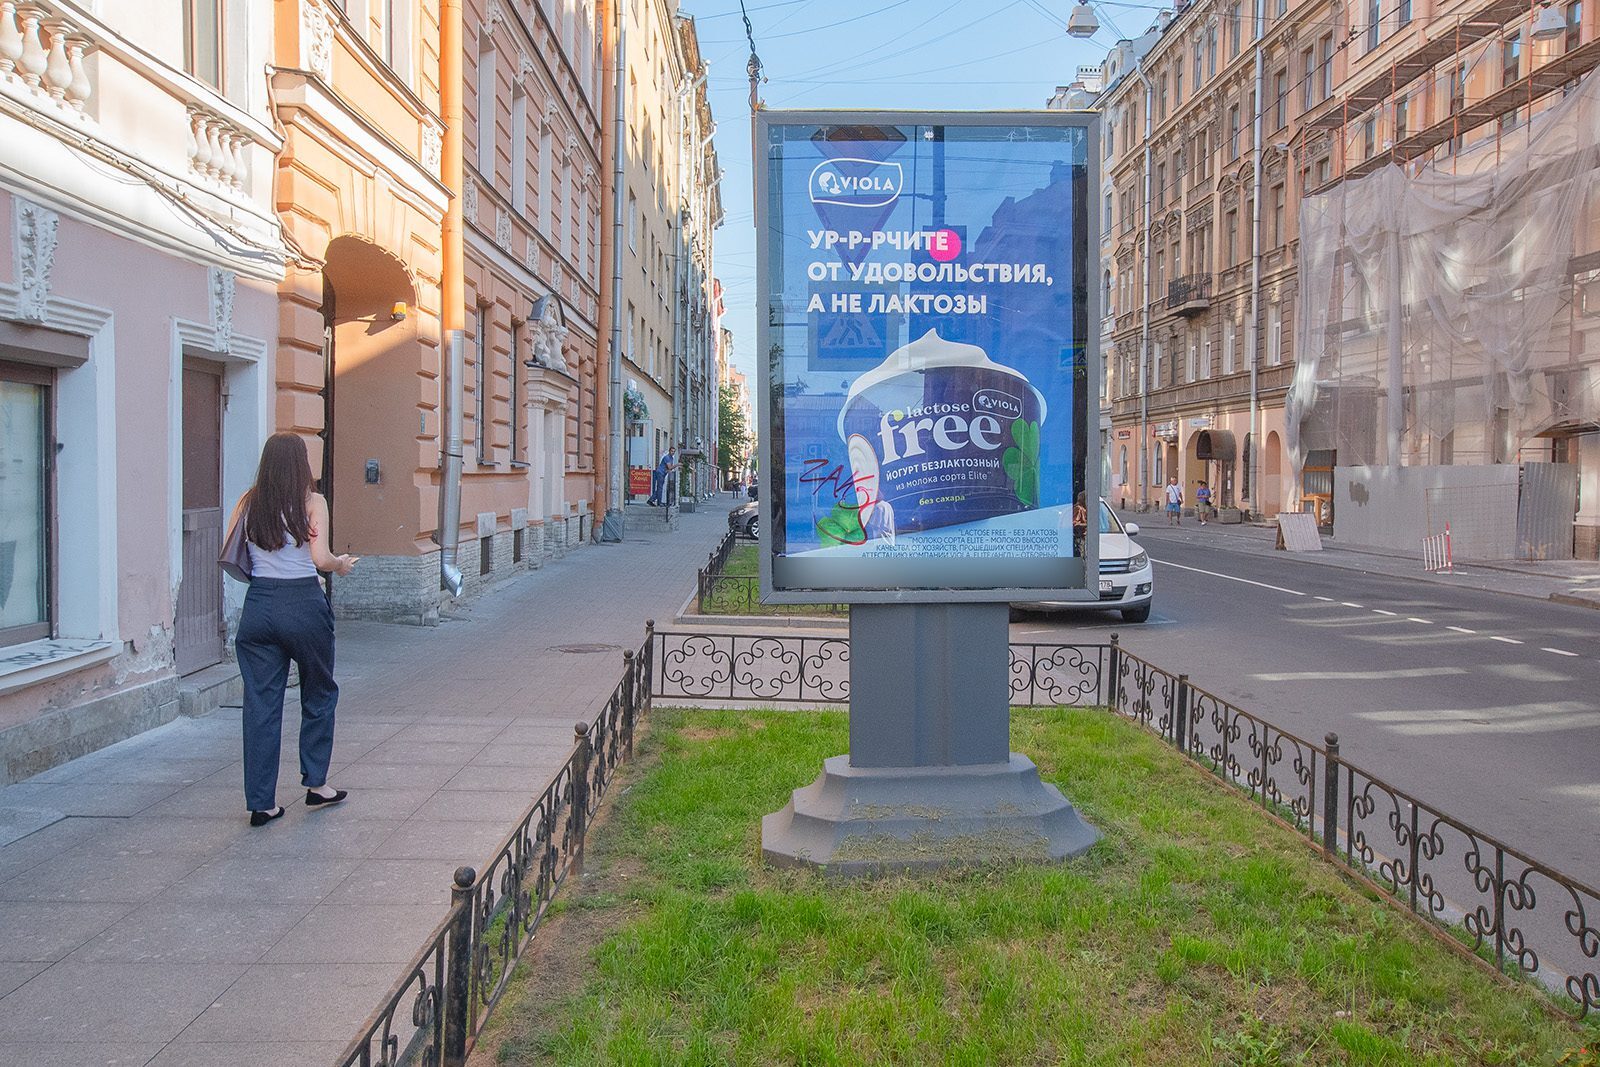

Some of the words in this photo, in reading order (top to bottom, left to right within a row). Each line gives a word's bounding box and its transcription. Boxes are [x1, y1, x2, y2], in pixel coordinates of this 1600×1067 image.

[840, 176, 895, 191] VIOLA
[807, 230, 949, 250] УР-Р-РЧИТЕ
[807, 262, 842, 281] ОТ
[848, 262, 1054, 286] УДОВОЛЬСТВИЯ,
[806, 294, 826, 313] А
[831, 294, 862, 313] НЕ
[868, 295, 987, 314] ЛАКТОЗЫ
[907, 402, 970, 419] lactose
[991, 398, 1019, 413] VIOLA
[877, 410, 1002, 466] free
[886, 464, 919, 481] ЙОГУРТ
[921, 457, 1000, 472] БЕЗЛАКТОЗНЫЙ
[896, 483, 905, 491] из
[906, 475, 938, 487] молока
[940, 472, 966, 482] сорта
[919, 497, 934, 506] без
